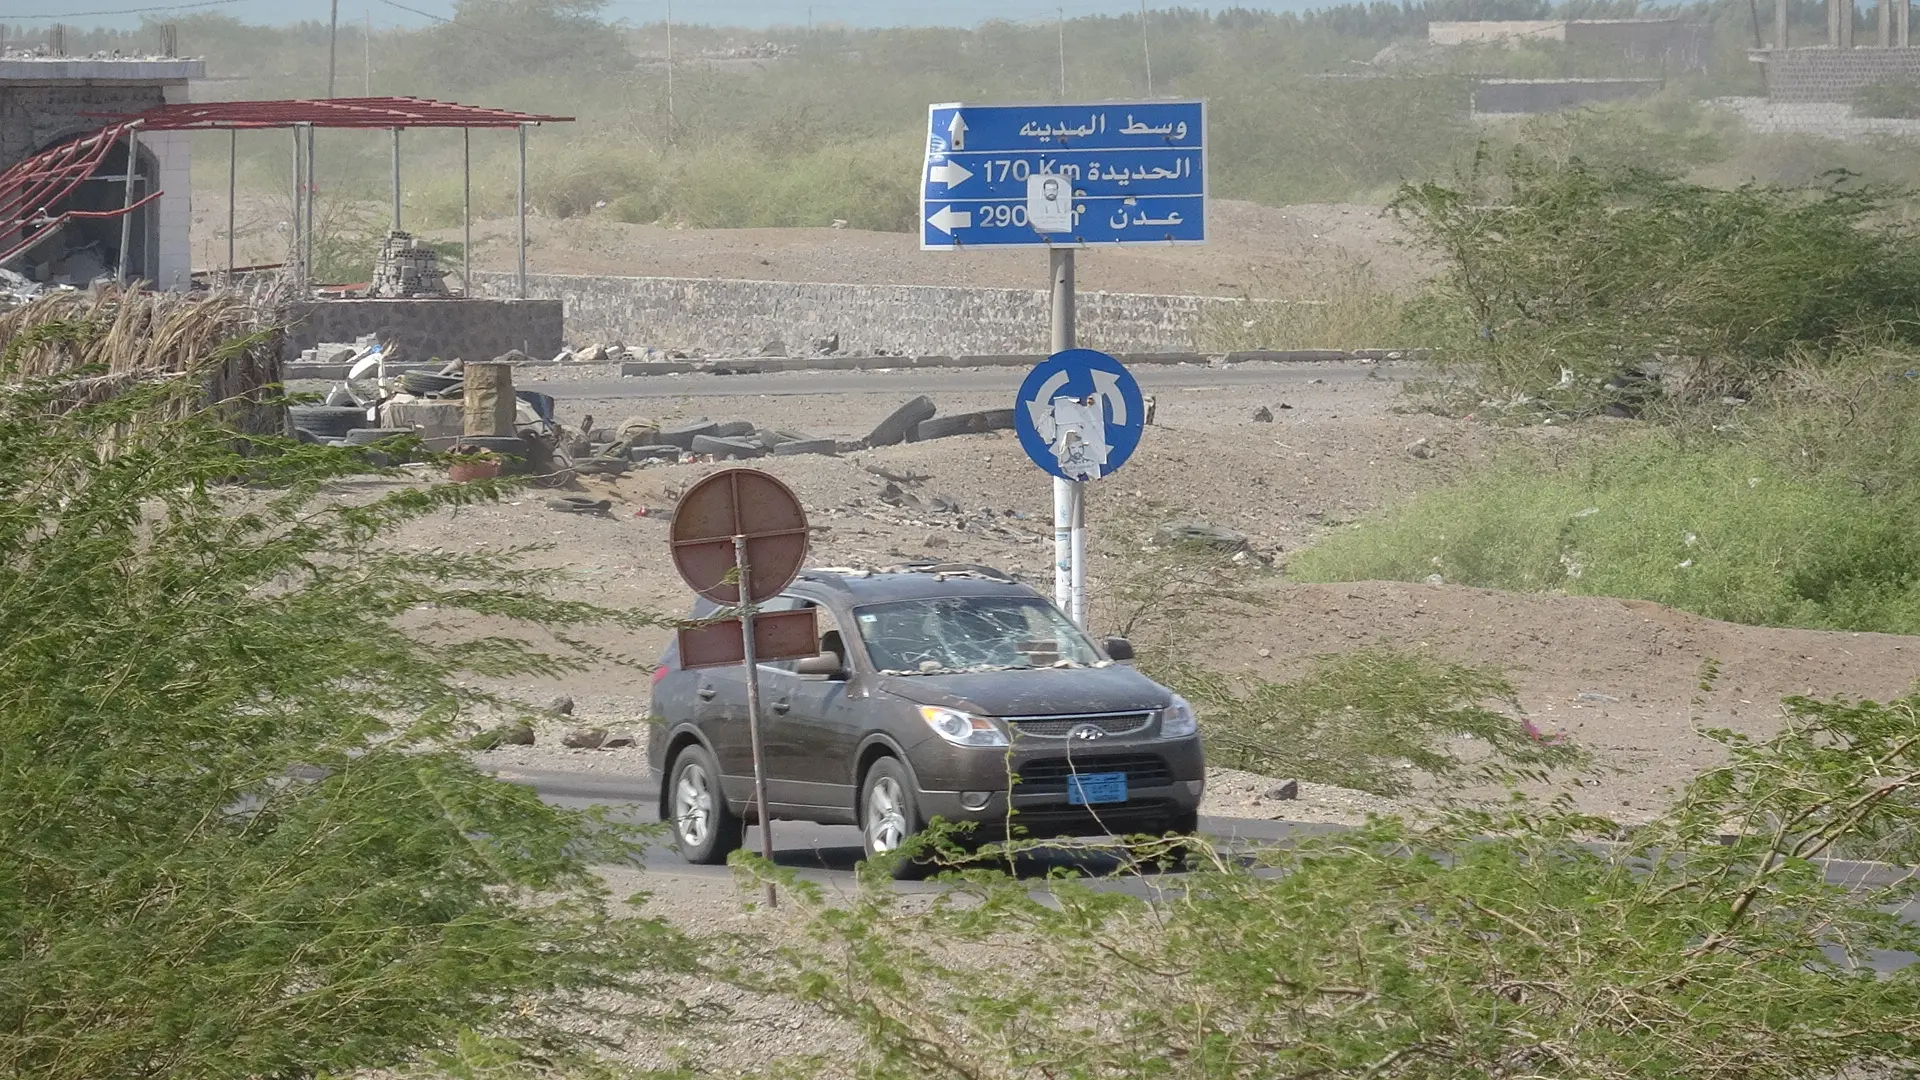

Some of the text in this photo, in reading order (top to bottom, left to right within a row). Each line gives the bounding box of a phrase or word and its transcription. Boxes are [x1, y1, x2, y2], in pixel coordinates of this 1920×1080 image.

[1019, 113, 1188, 142] وسط المدينه
[983, 159, 1080, 182] 170 Km
[1087, 156, 1191, 186] الحديدة
[979, 204, 1028, 228] 290
[1109, 208, 1184, 230] عدن
